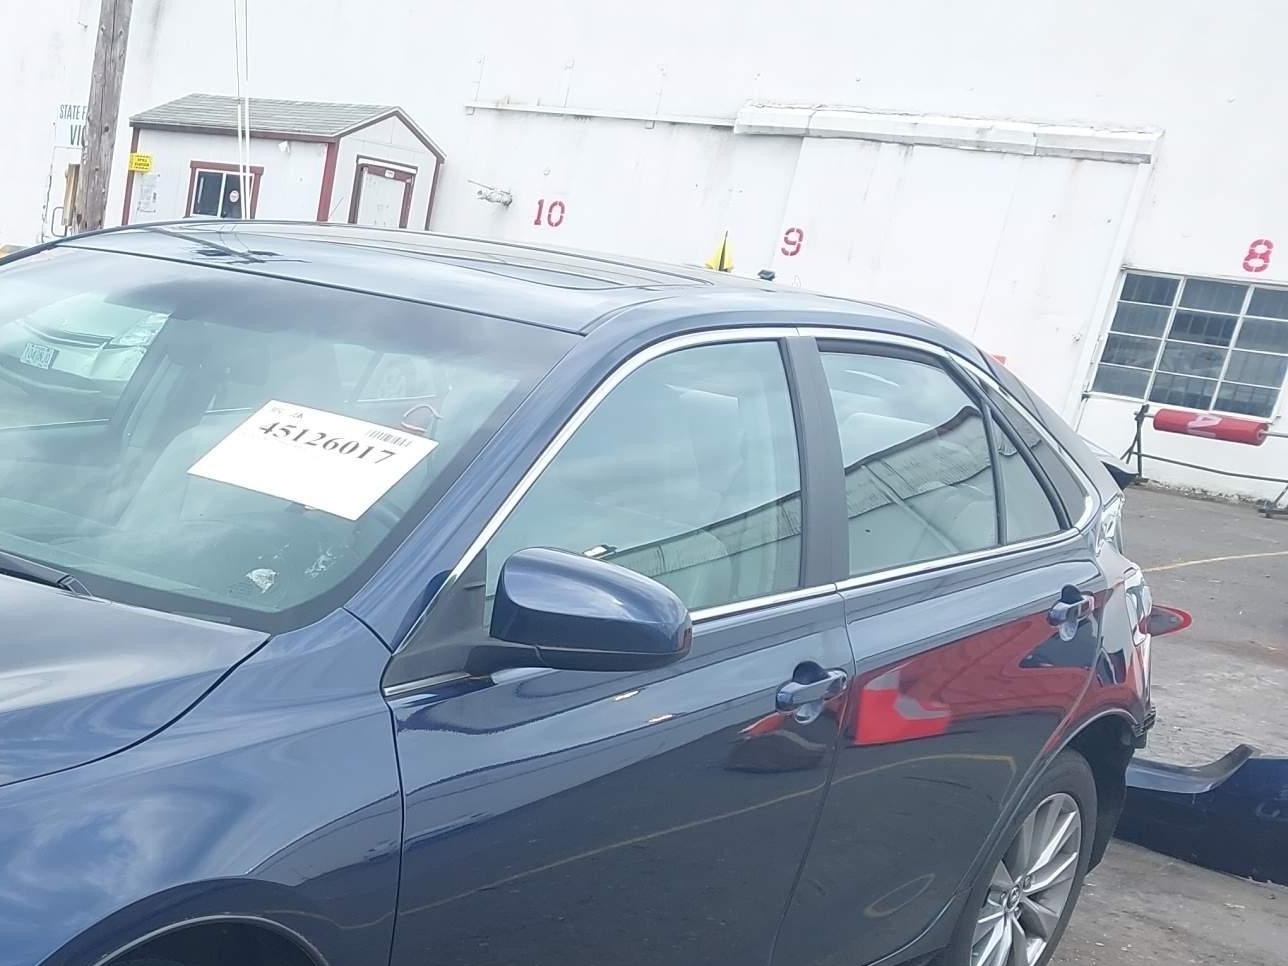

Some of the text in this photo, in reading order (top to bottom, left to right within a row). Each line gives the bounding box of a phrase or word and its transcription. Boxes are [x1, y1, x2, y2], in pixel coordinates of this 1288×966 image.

[59, 104, 81, 121] STATE
[534, 199, 565, 227] 10
[781, 227, 803, 256] 9
[1242, 239, 1273, 272] 8
[259, 421, 396, 464] 45126017
